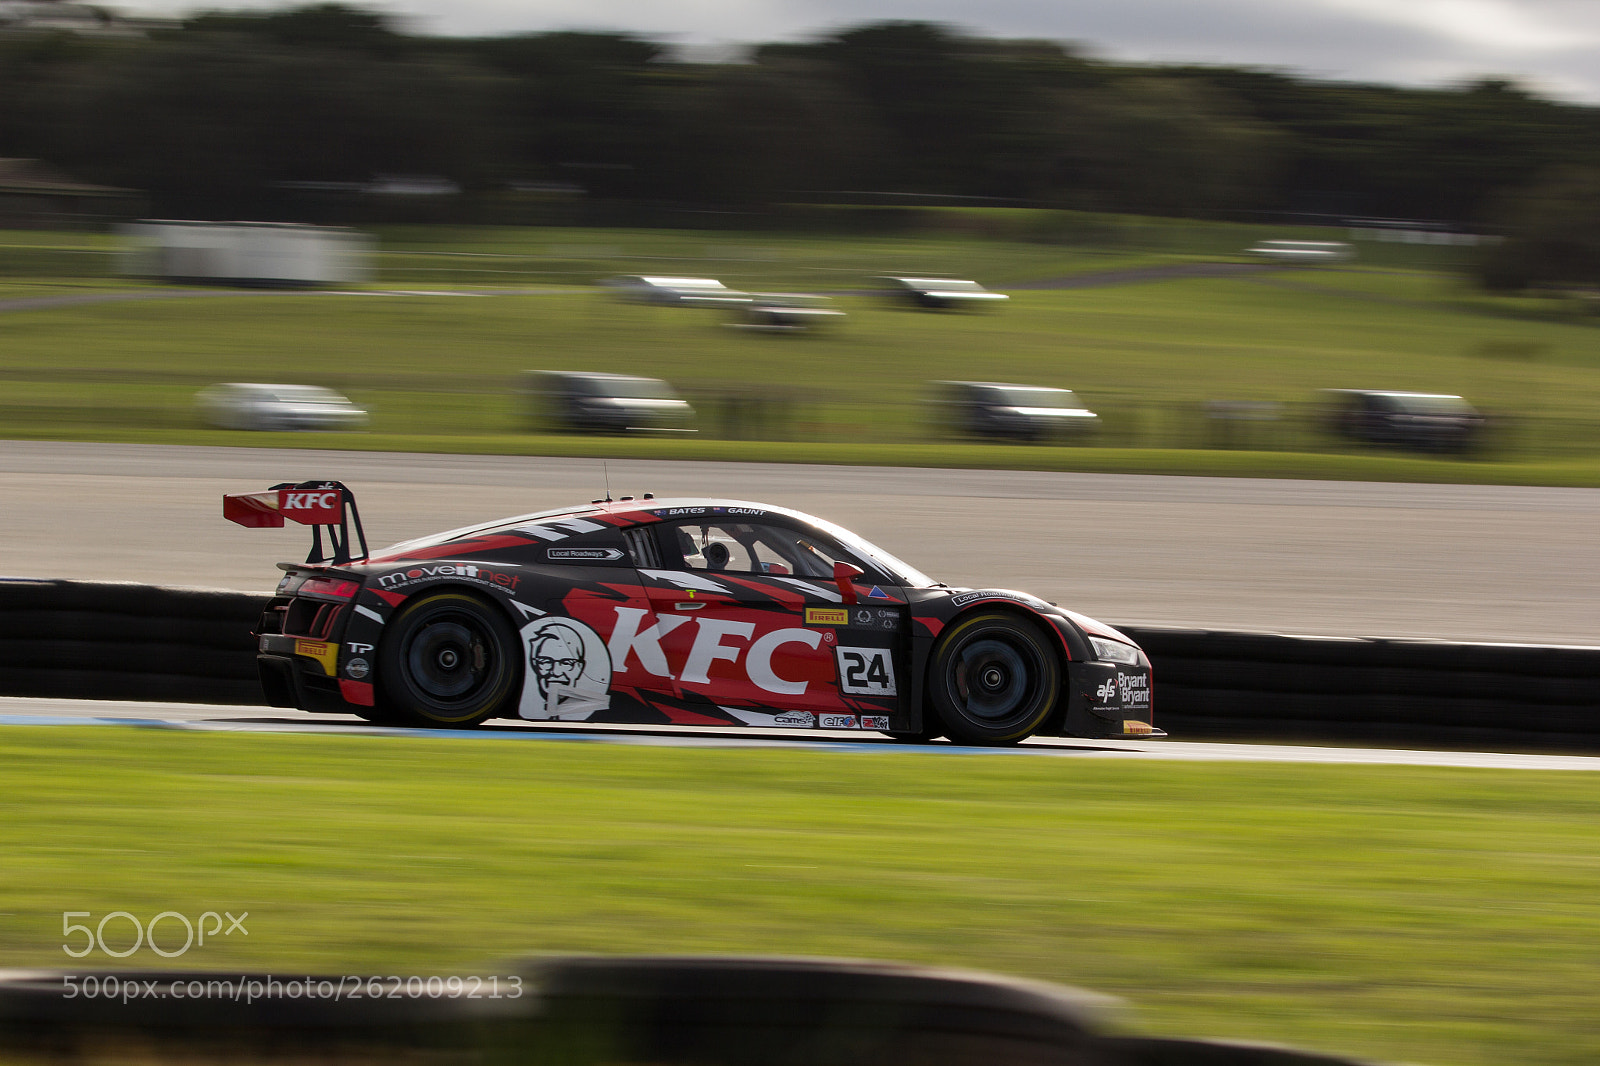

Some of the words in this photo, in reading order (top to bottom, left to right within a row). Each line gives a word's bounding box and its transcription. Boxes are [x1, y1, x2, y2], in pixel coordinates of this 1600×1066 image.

[283, 492, 337, 510] KFC
[669, 507, 706, 515] BATES
[728, 507, 766, 516] GAUNT
[570, 550, 603, 558] Roadways
[809, 610, 845, 622] PIRELLI
[346, 641, 374, 654] TP
[611, 606, 823, 695] KFC
[842, 651, 890, 689] 24
[1118, 672, 1147, 690] Bryant
[1096, 678, 1116, 703] afs
[1121, 687, 1150, 705] Bryant
[824, 716, 844, 726] elf
